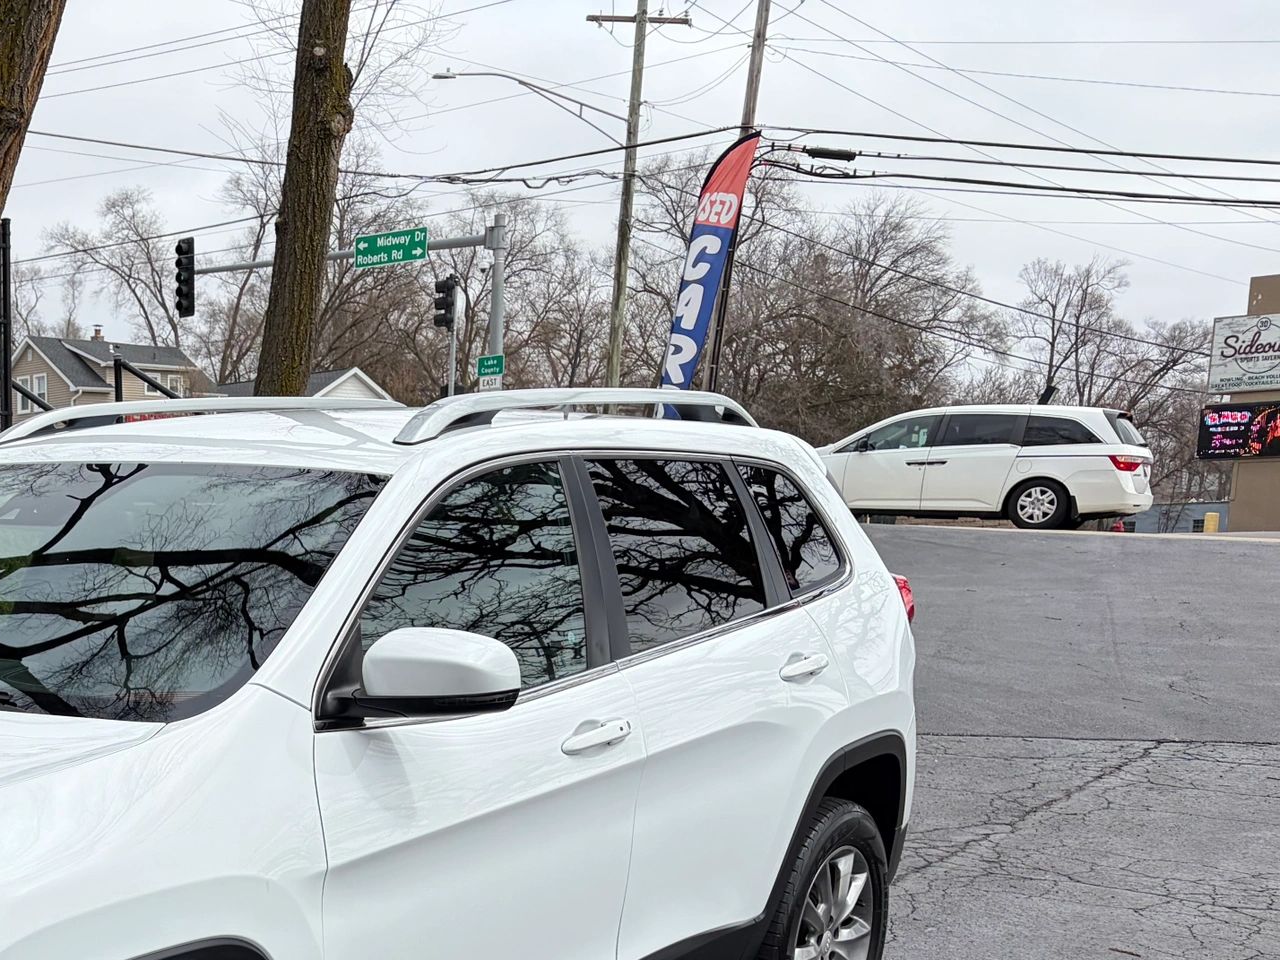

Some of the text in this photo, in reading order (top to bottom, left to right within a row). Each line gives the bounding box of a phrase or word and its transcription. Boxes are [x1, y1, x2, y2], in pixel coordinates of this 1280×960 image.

[377, 231, 425, 247] Midway Dr
[357, 249, 403, 265] Roberts Rd
[483, 378, 497, 387] EAST
